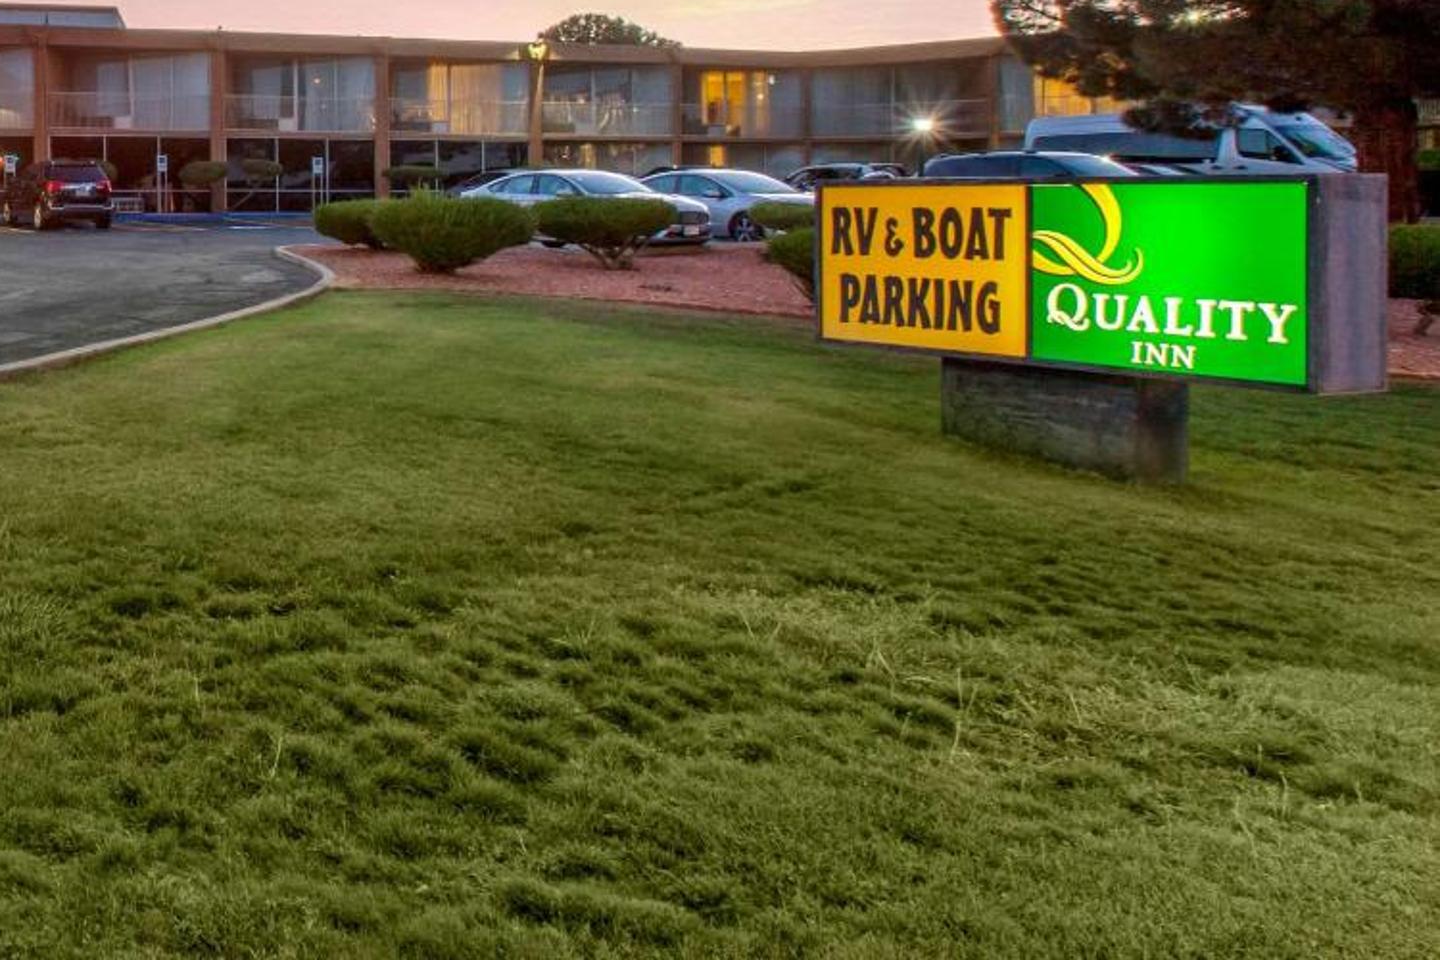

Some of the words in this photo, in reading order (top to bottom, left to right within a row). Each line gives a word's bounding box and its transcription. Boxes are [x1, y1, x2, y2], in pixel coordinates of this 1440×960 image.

[831, 207, 878, 256] RV
[884, 217, 904, 257] &
[912, 207, 1012, 260] BOAT
[839, 273, 1001, 335] PARKING
[1046, 283, 1298, 344] QUALITY
[1131, 341, 1196, 369] INN
